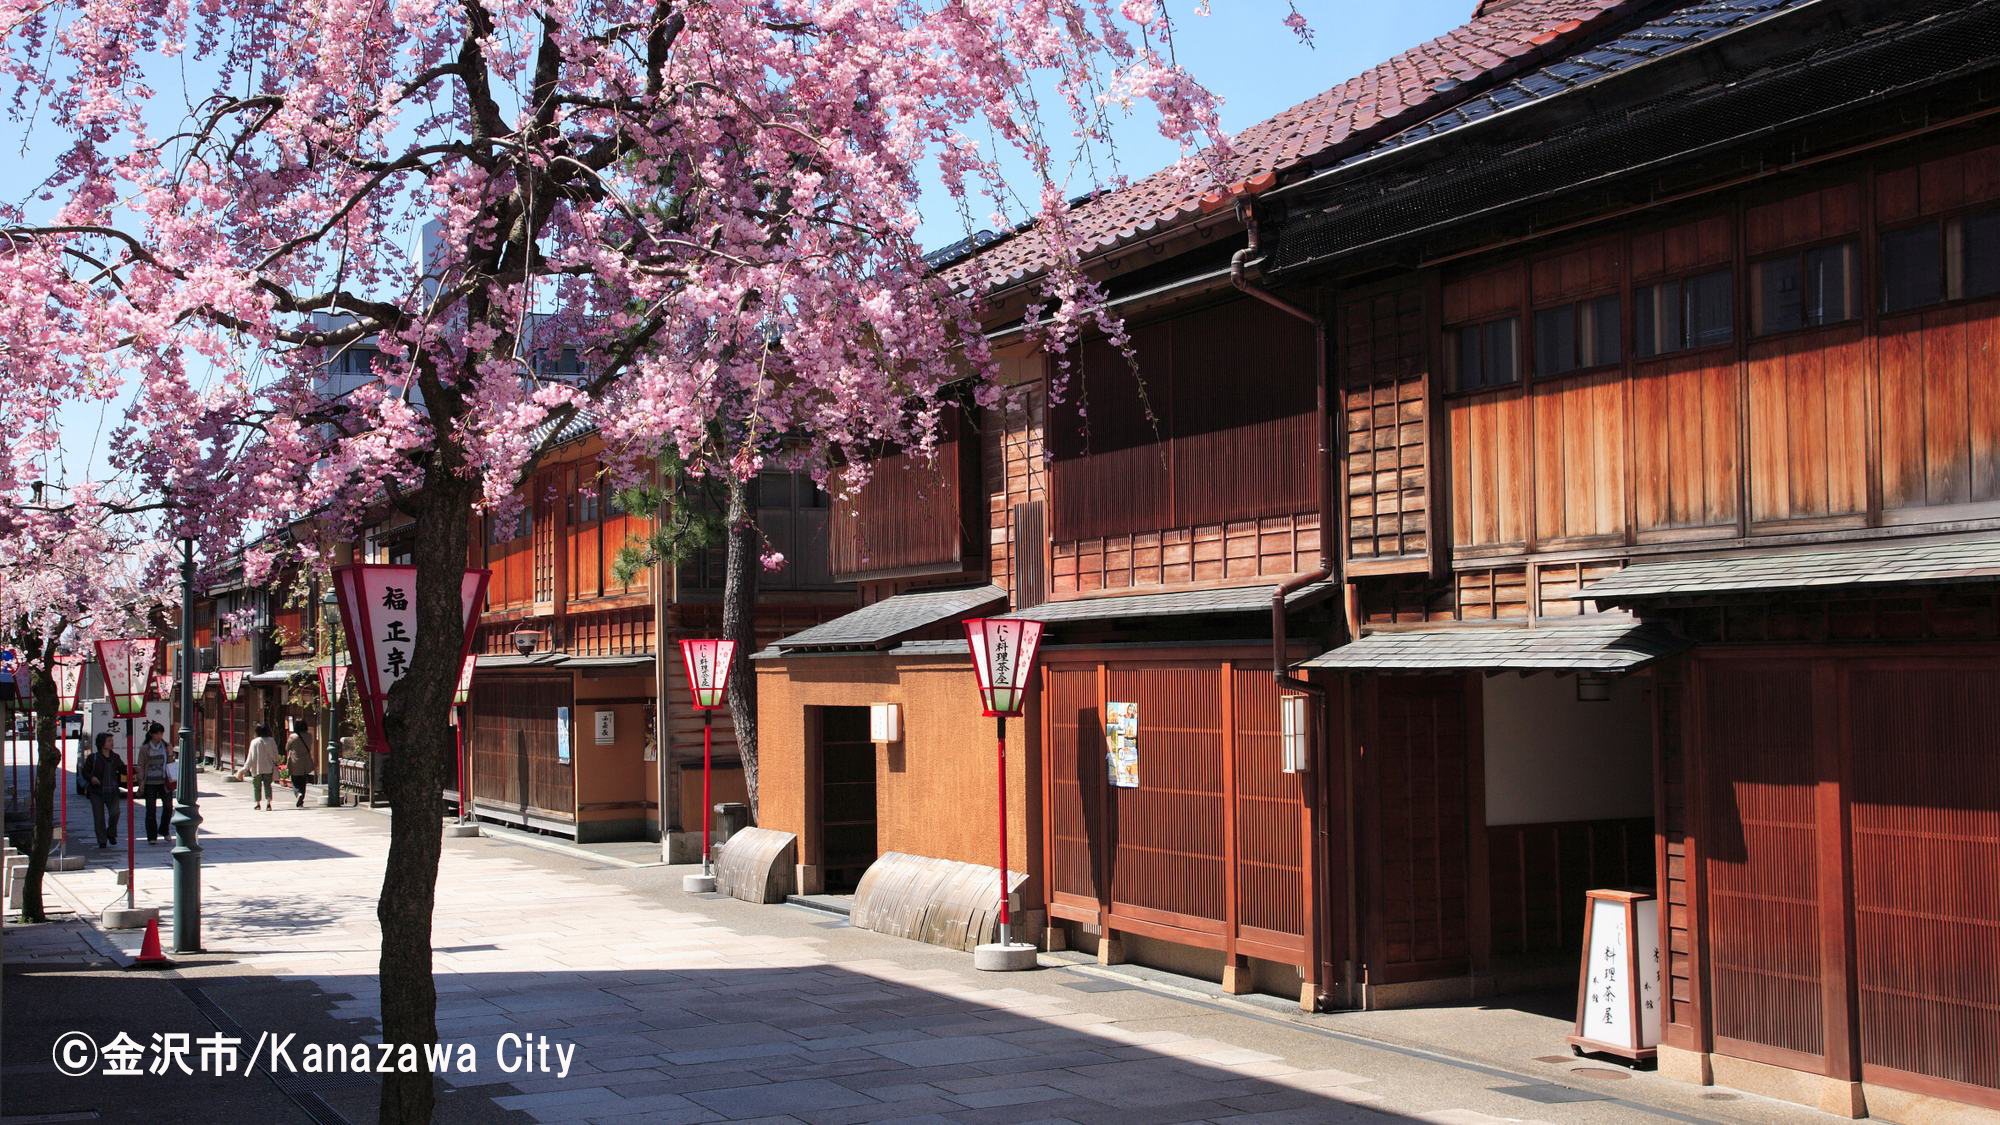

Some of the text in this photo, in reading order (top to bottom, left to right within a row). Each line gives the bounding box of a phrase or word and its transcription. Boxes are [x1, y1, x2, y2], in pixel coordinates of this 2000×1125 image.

[381, 586, 411, 678] 福正宗
[995, 624, 1010, 685] にし料理茶屋
[1603, 945, 1616, 1025] 料理茶屋
